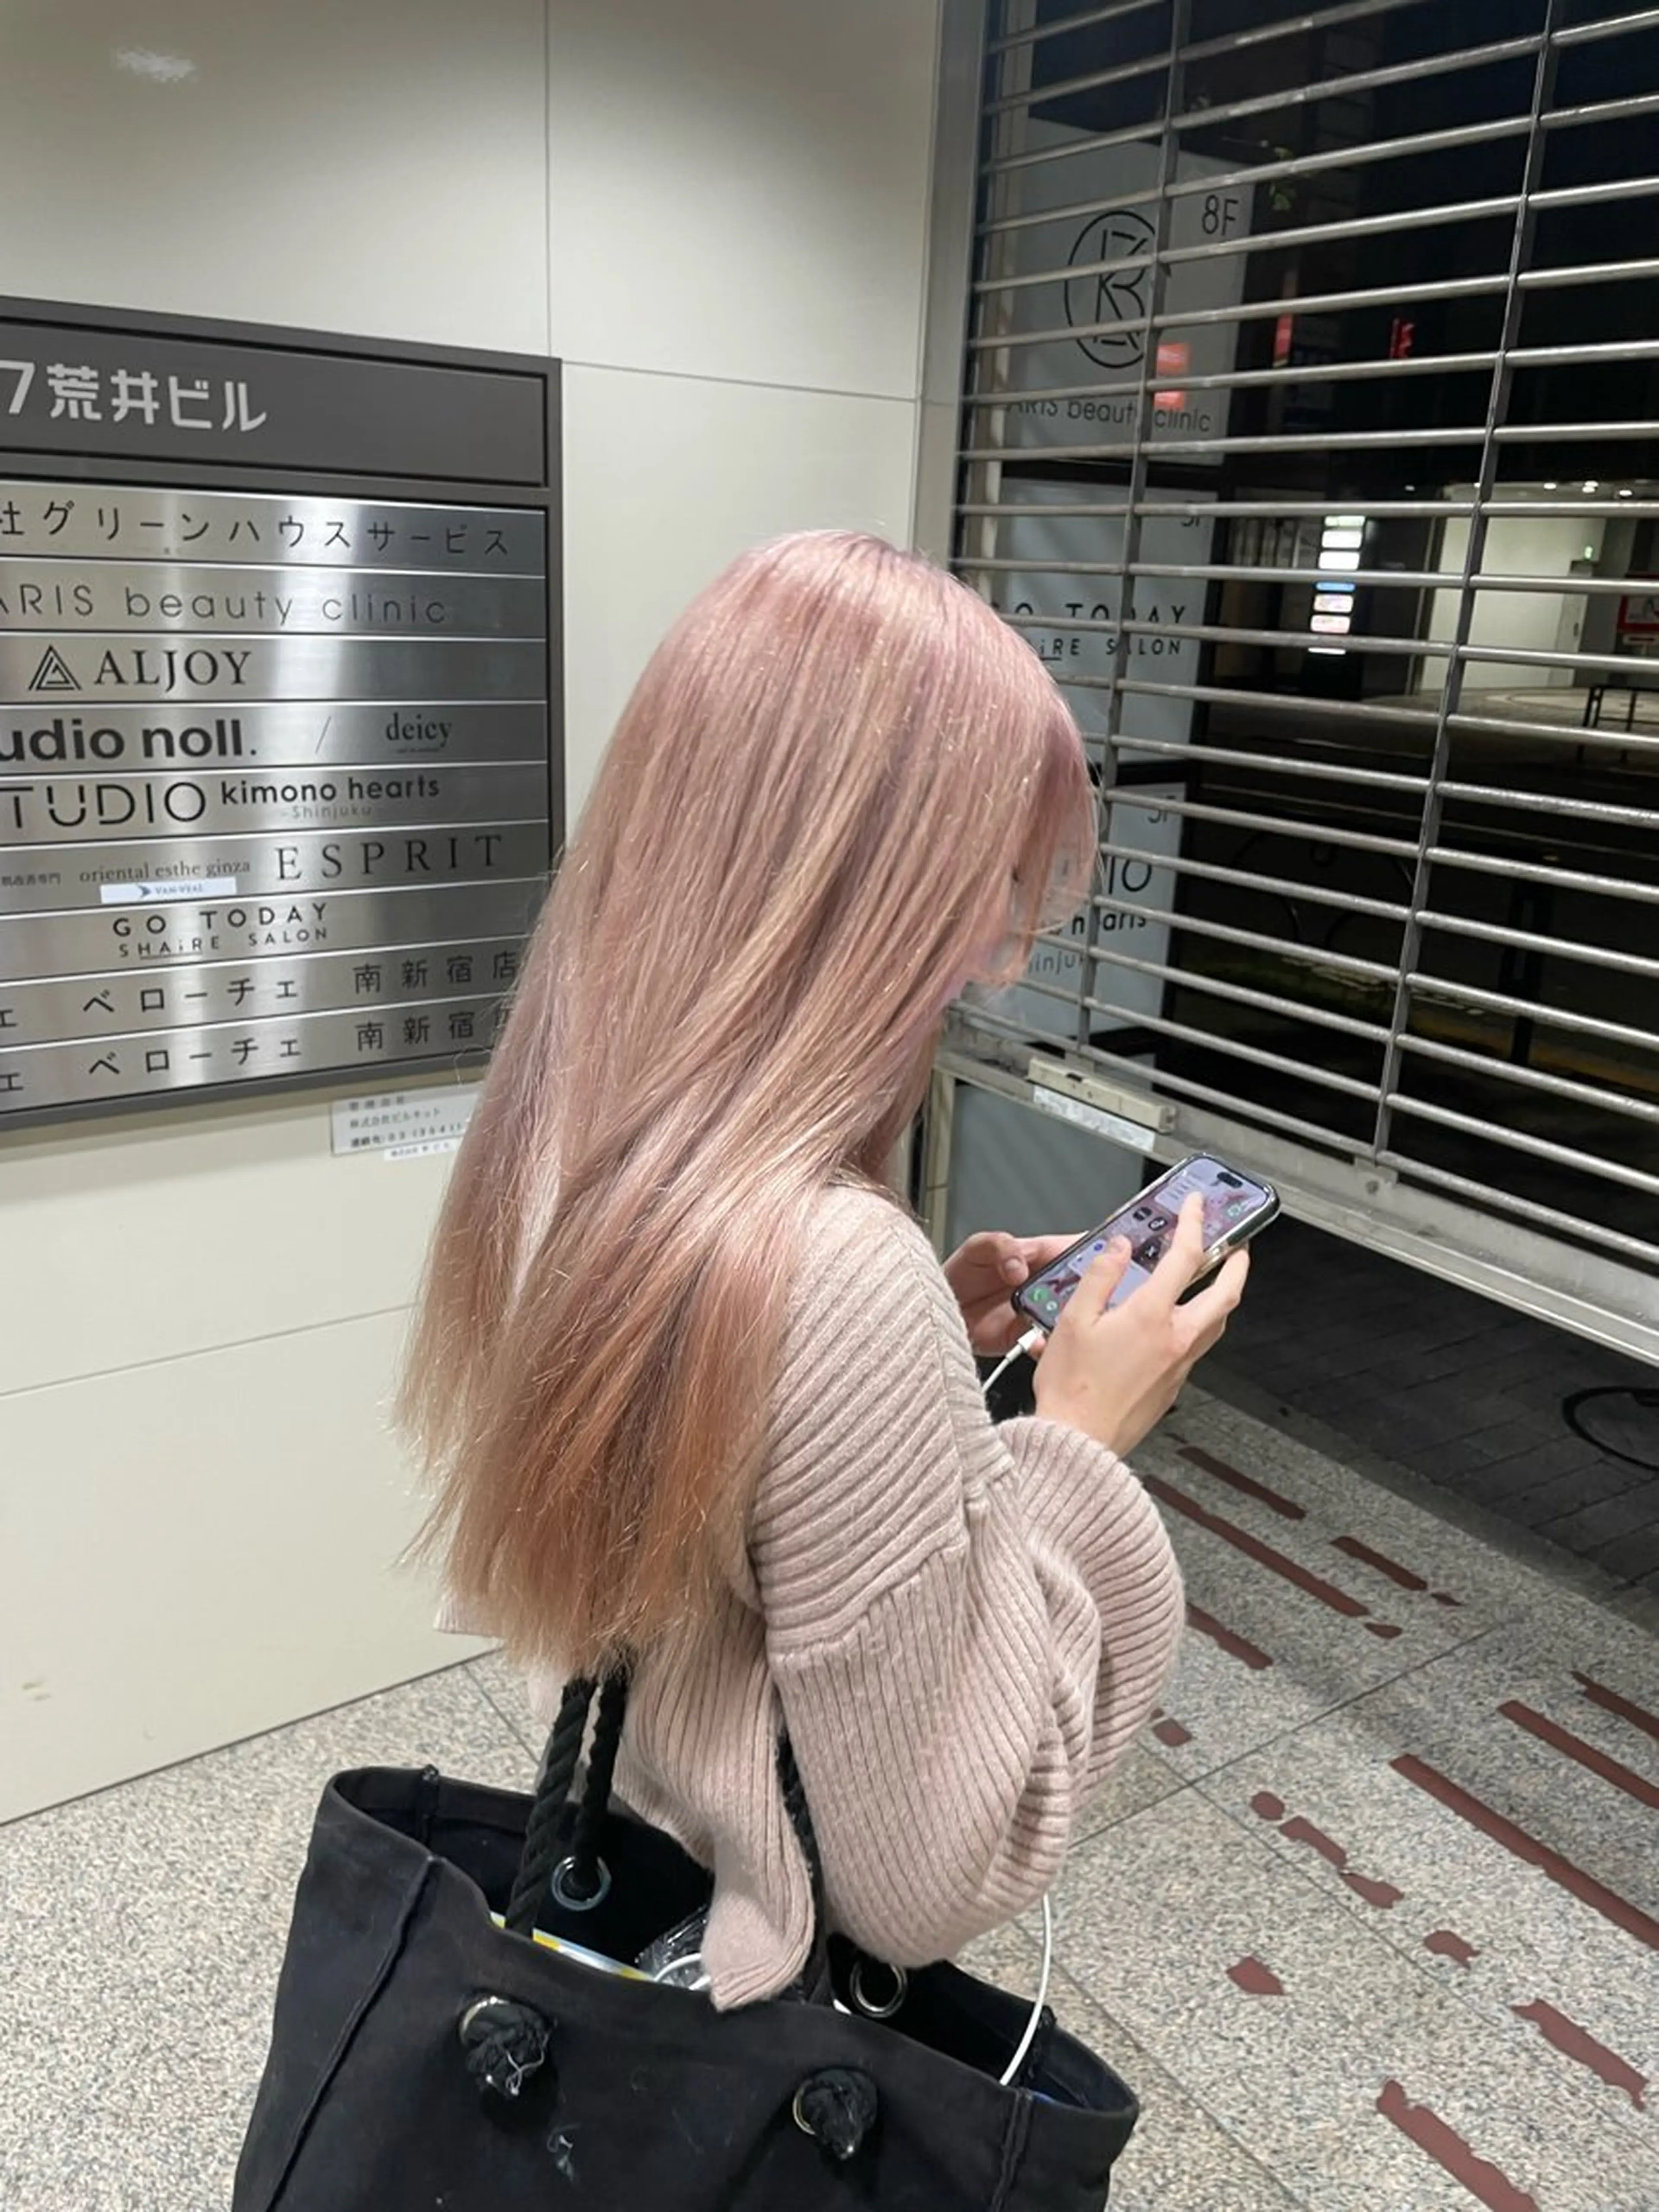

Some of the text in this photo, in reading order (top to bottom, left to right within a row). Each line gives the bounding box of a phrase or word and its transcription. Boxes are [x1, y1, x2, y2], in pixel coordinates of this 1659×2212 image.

[1201, 194, 1239, 236] 8F
[1066, 400, 1137, 425] beaut
[1154, 406, 1211, 432] clinic
[125, 586, 292, 626] beauty
[322, 594, 445, 623] clinic
[1065, 604, 1185, 623] TOAY
[1106, 638, 1181, 655] SLON
[93, 649, 252, 692] ALJOY
[142, 718, 257, 758] noll.
[386, 711, 453, 748] deicy
[0, 775, 440, 829] TUDIO kimono hearts
[79, 859, 251, 884] oriental esthe ginza
[275, 835, 502, 880] ESPRIT
[113, 902, 327, 937] GO TODAY
[248, 928, 327, 947] SALON
[83, 978, 299, 1013] ベローチェ
[353, 950, 518, 994] 南新宿店
[89, 1039, 302, 1075] ベローチェ
